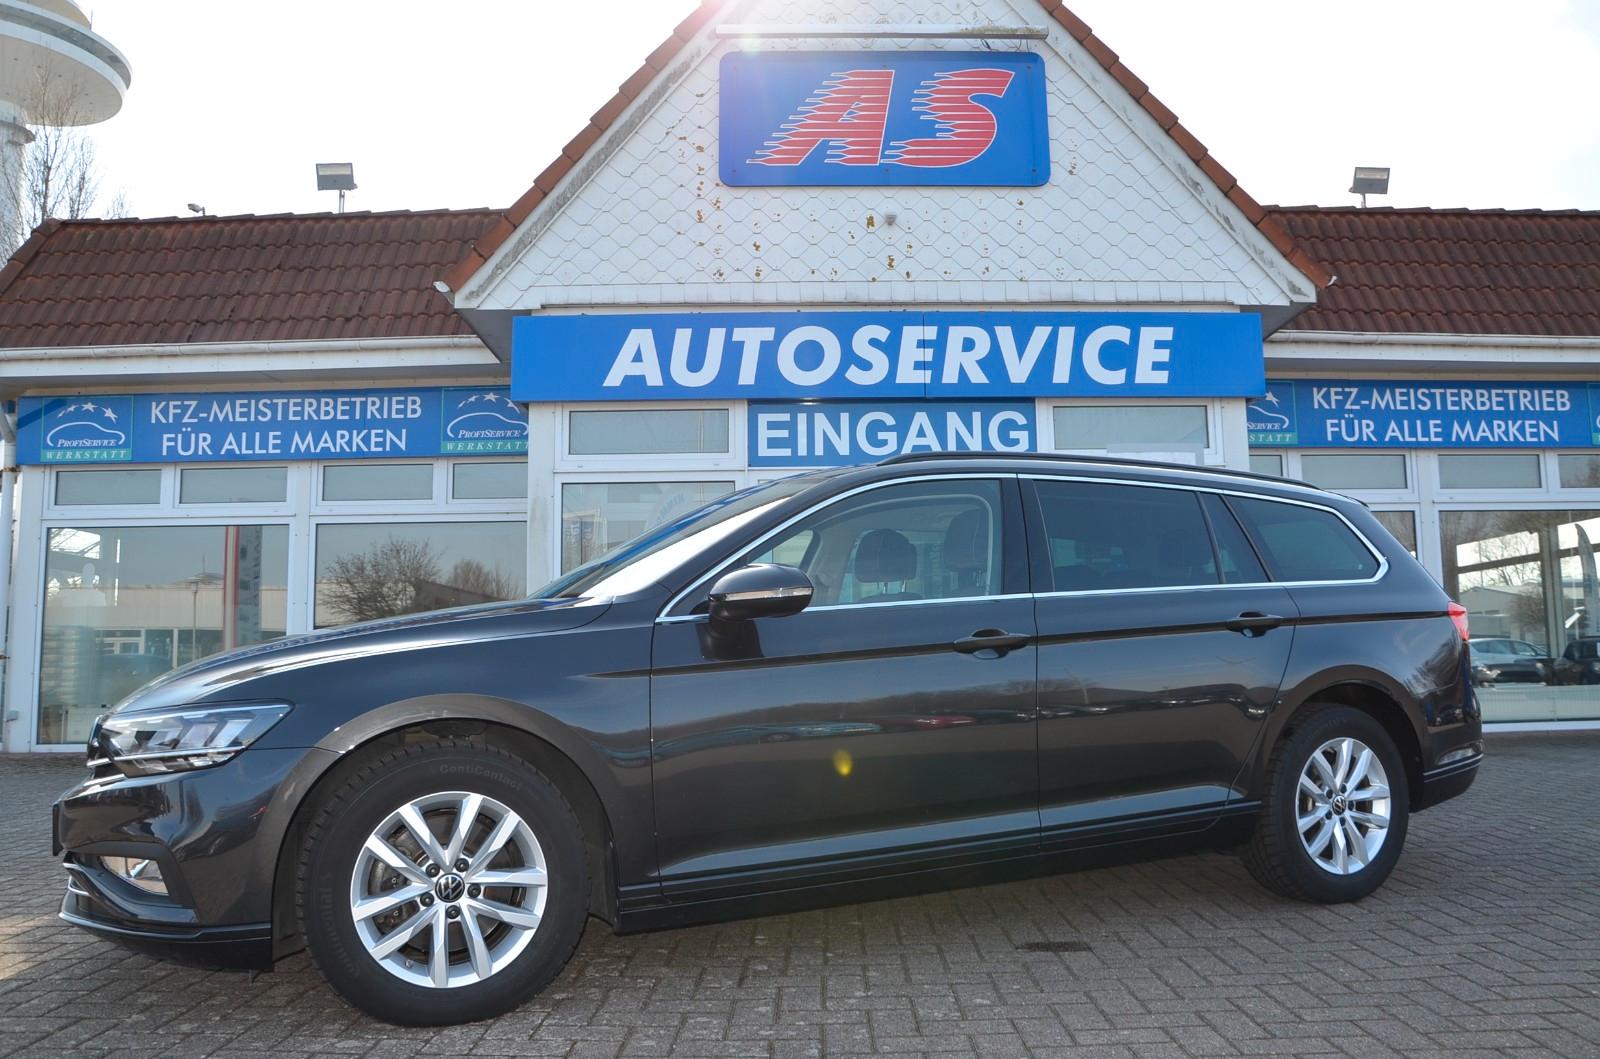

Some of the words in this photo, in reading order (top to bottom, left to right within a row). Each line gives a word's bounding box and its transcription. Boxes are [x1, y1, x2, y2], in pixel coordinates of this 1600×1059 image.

[746, 68, 1015, 167] AS
[602, 325, 1174, 387] AUTOSERVICE
[150, 396, 422, 424] KFZ-MEISTERBETRIEB
[1312, 387, 1571, 411] KFZ-MEISTERBETRIEB
[162, 427, 213, 456] FÜR
[220, 431, 282, 455] ALLE
[290, 428, 407, 454] MARKEN
[757, 411, 1030, 457] EINGANG
[1326, 414, 1377, 442] FÜR
[1384, 420, 1443, 442] ALLE
[1451, 420, 1559, 442] MARKEN
[46, 450, 127, 460] WERKSTATT
